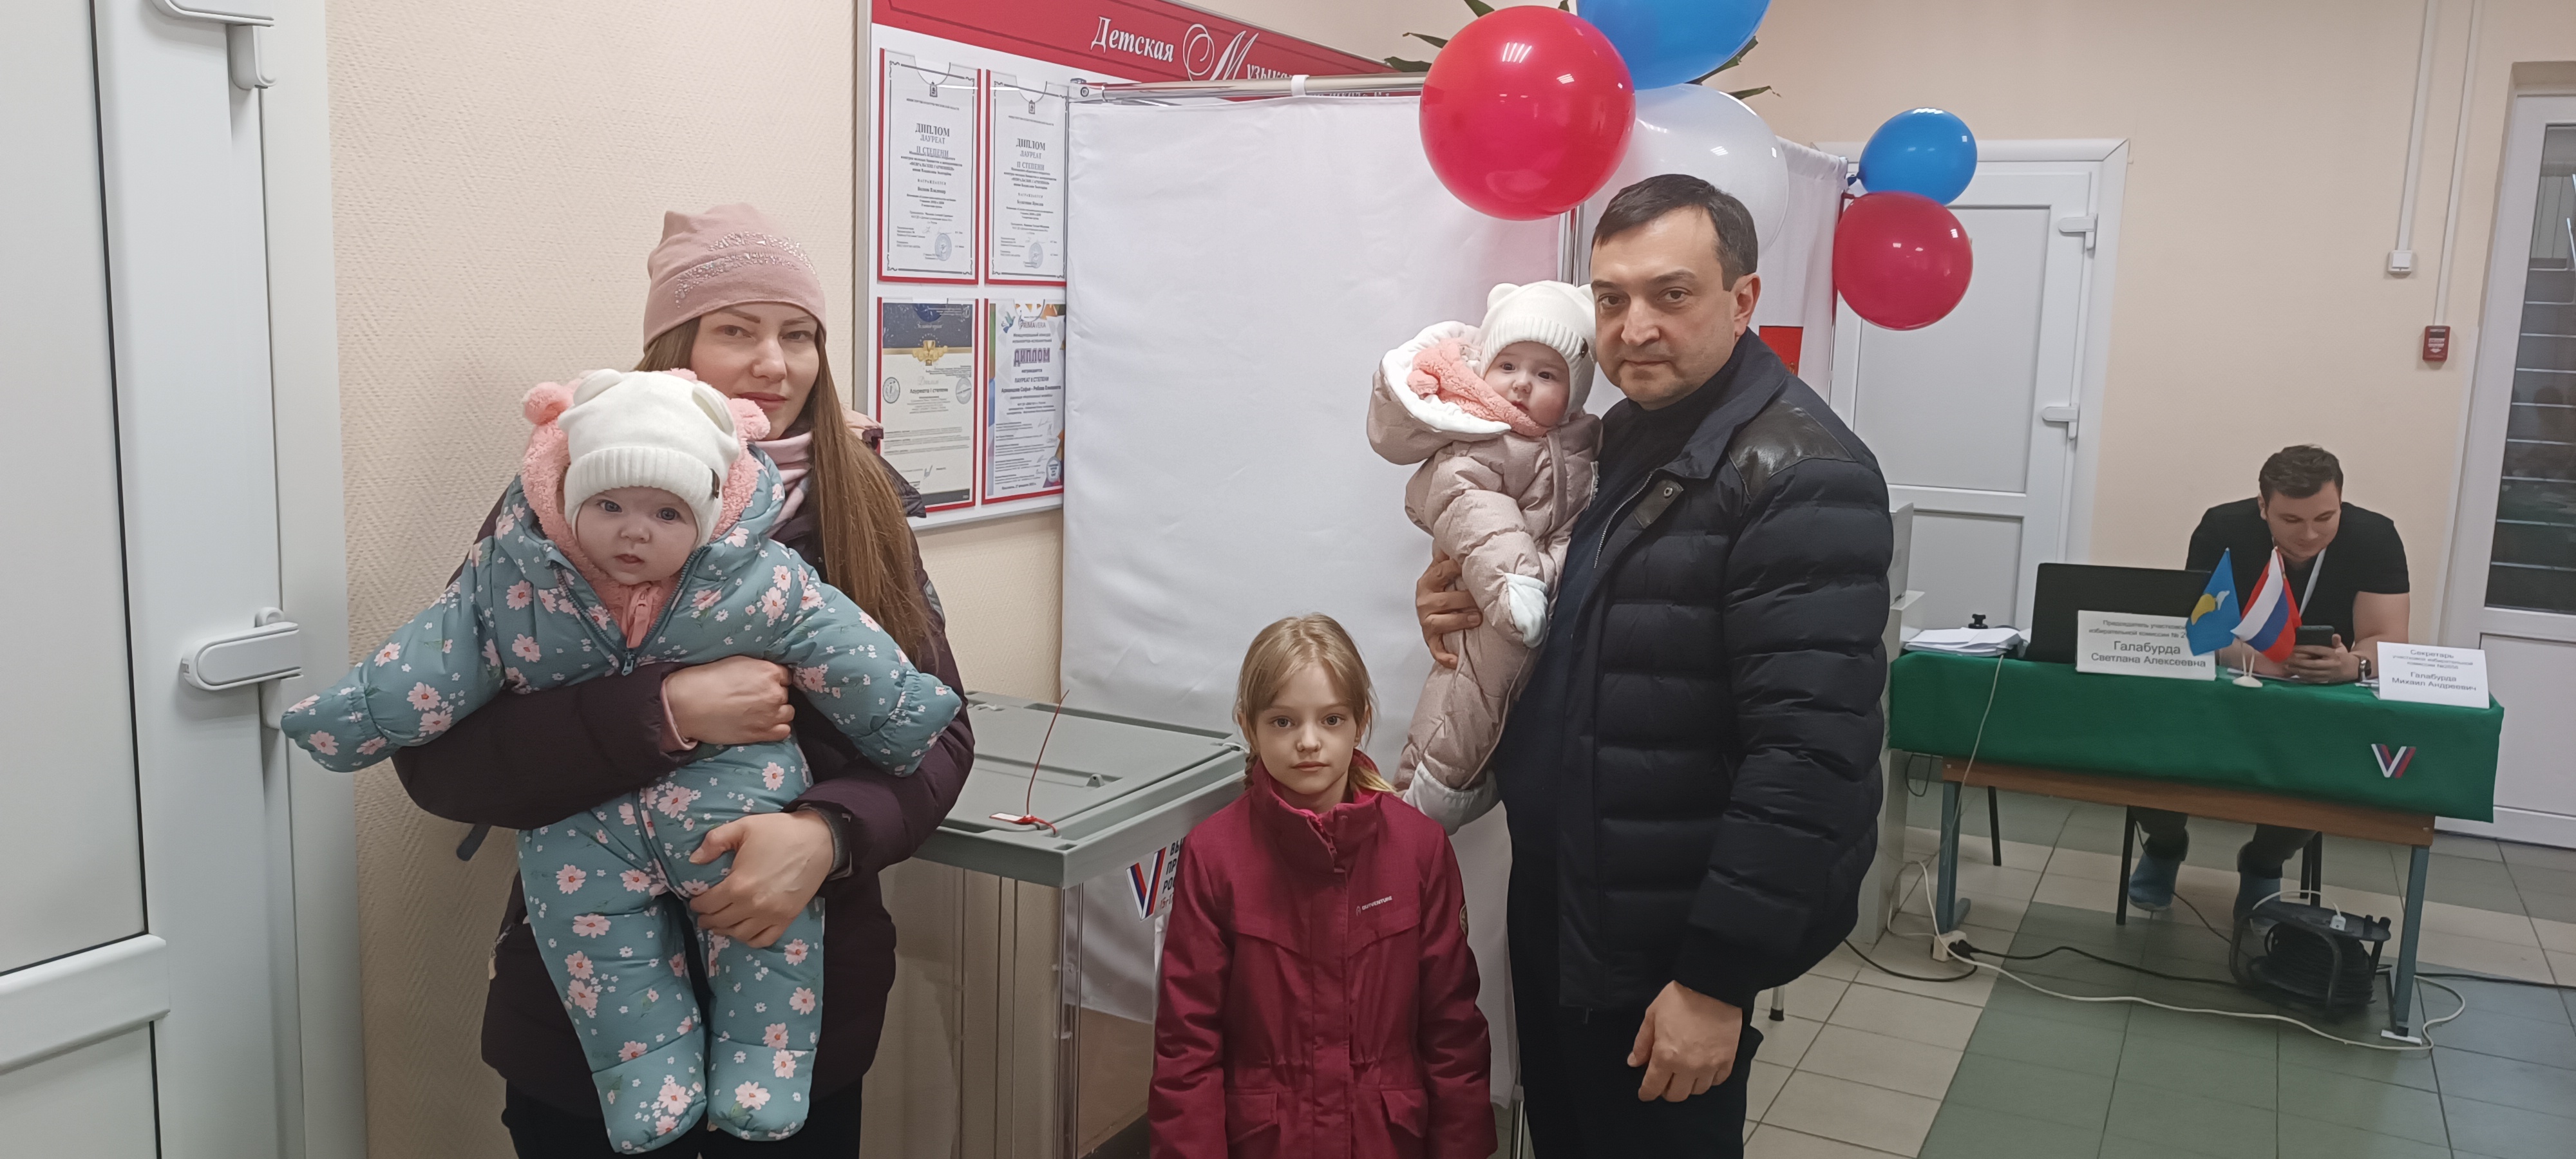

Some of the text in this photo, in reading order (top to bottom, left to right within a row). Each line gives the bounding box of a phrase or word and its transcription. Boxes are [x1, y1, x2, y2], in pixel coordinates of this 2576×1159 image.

[1090, 16, 1293, 80] Детская Музык
[915, 123, 950, 137] ДИПЛОМ
[920, 135, 945, 144] ЛАУРЕАТ
[1016, 138, 1046, 151] ДИПЛОМ
[922, 147, 949, 157] СТЕПЕНИ
[1019, 150, 1042, 159] ЛАУРЕАТ
[1022, 162, 1045, 171] СТЕПЕНИ
[1014, 348, 1050, 366] ДИПЛОМ
[2114, 641, 2181, 655] Галабурда
[2410, 649, 2454, 659] Секретарь
[2091, 652, 2206, 668] Светлана Алексеевна
[2410, 672, 2457, 682] Галабурда
[2392, 677, 2477, 691] Михаил Андреевич
